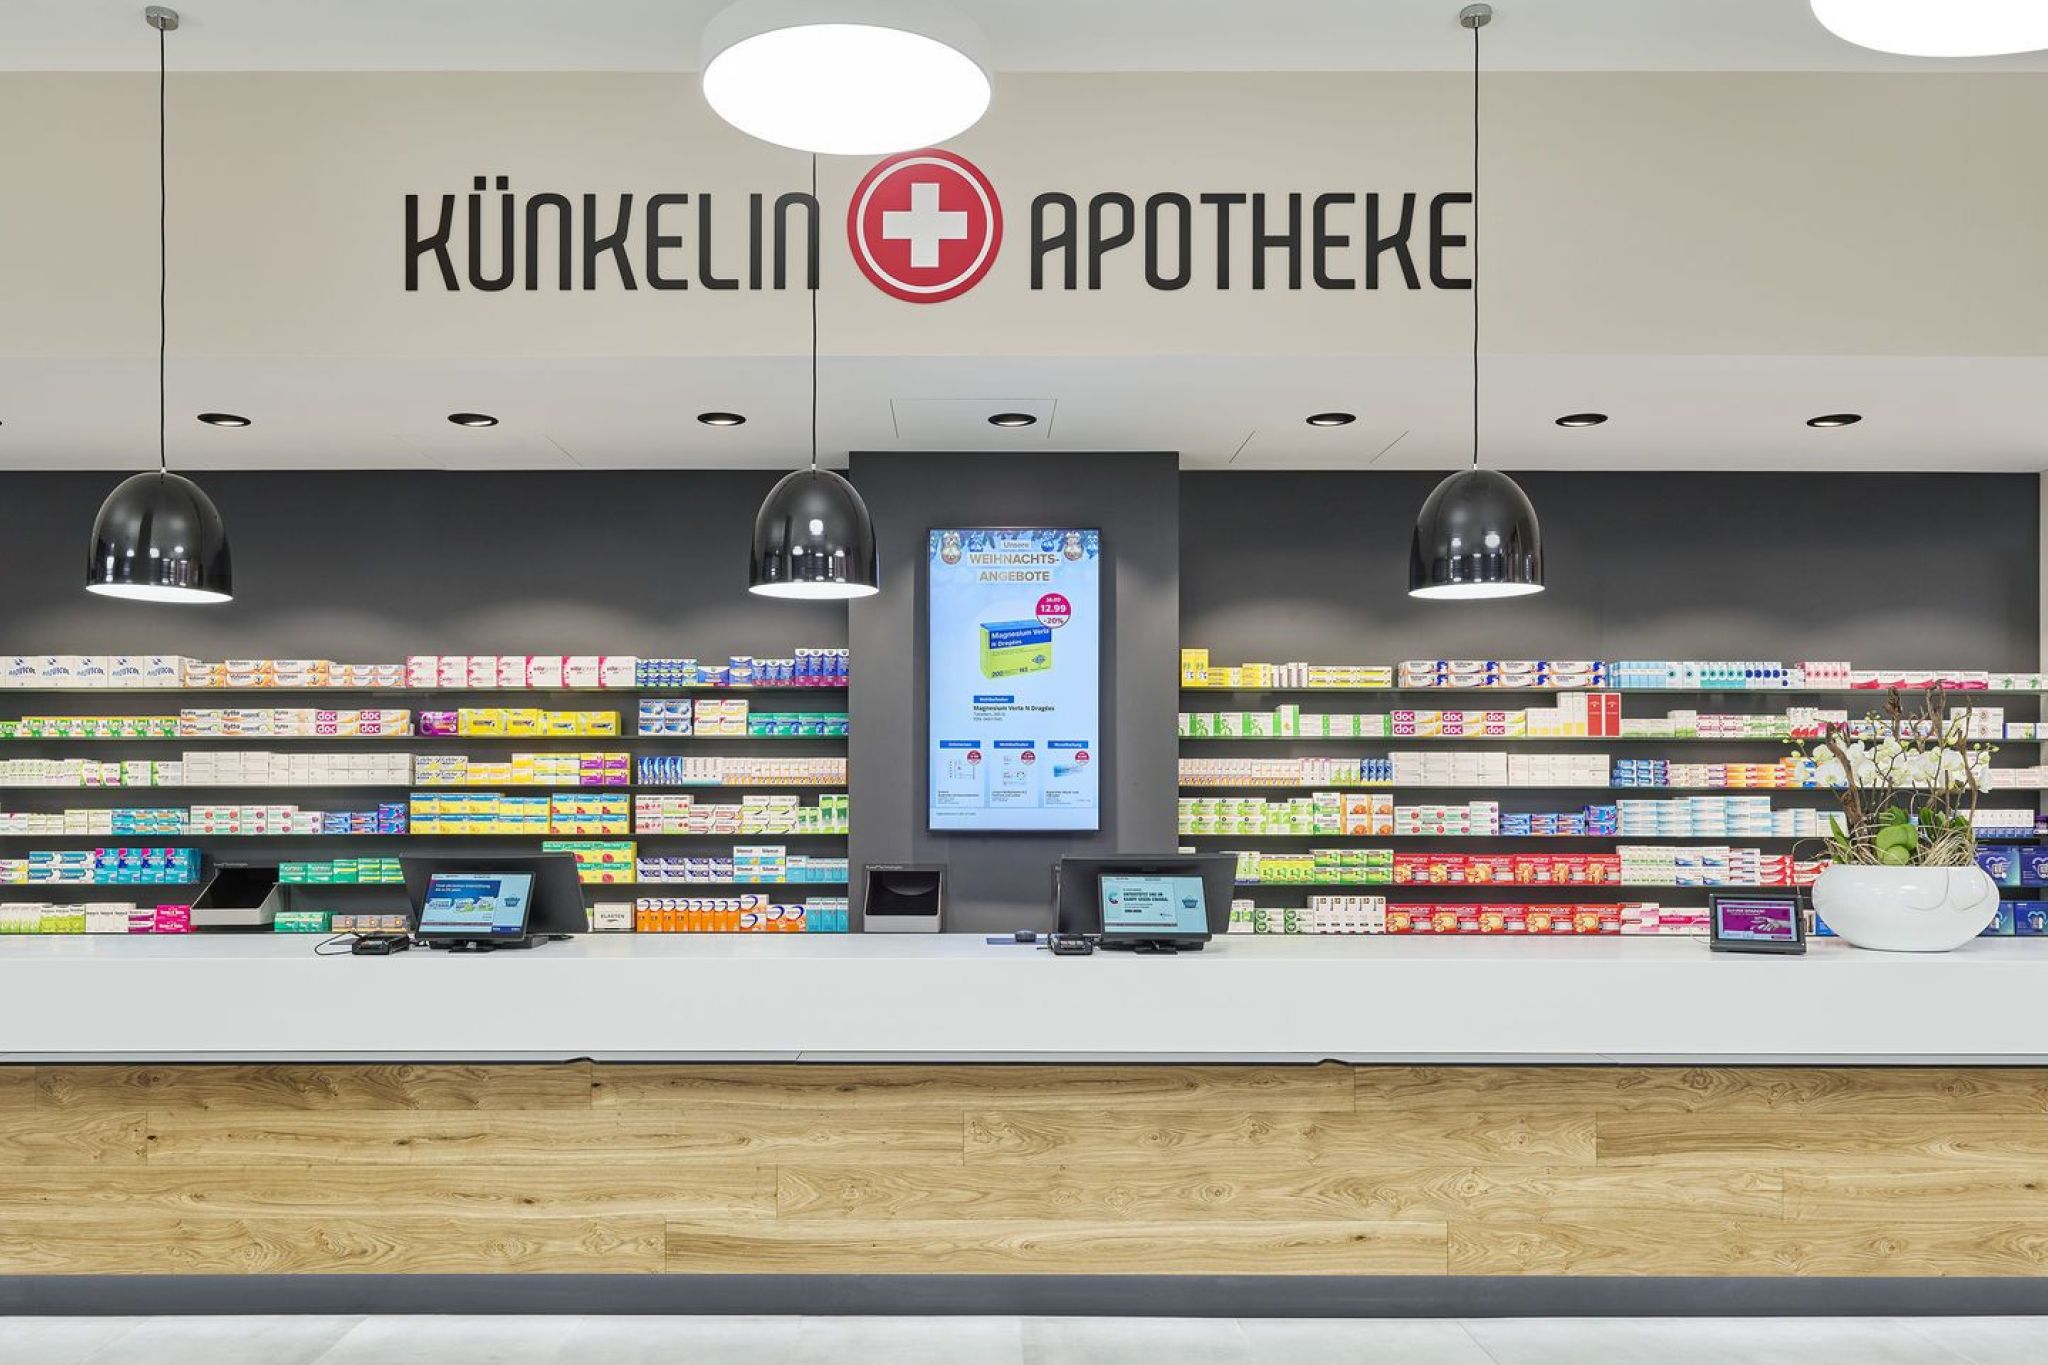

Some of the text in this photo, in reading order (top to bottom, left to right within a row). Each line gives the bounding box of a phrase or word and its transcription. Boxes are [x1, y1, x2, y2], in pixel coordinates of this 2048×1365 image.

[404, 175, 1473, 291] KÜNKELIN APOTHEKE
[969, 553, 1060, 565] WEIHNACHTS-
[979, 570, 1051, 582] ANGEBOTE
[1040, 604, 1067, 613] 12.99
[991, 630, 1032, 640] Magnesium
[317, 712, 337, 722] doc
[361, 711, 380, 720] doc
[1394, 712, 1415, 721] doc
[1443, 712, 1463, 721] doc
[1486, 712, 1505, 721] doc
[317, 724, 337, 734] doc
[361, 724, 380, 733] doc
[1394, 725, 1415, 734] doc
[1443, 725, 1463, 734] doc
[1486, 725, 1505, 734] doc
